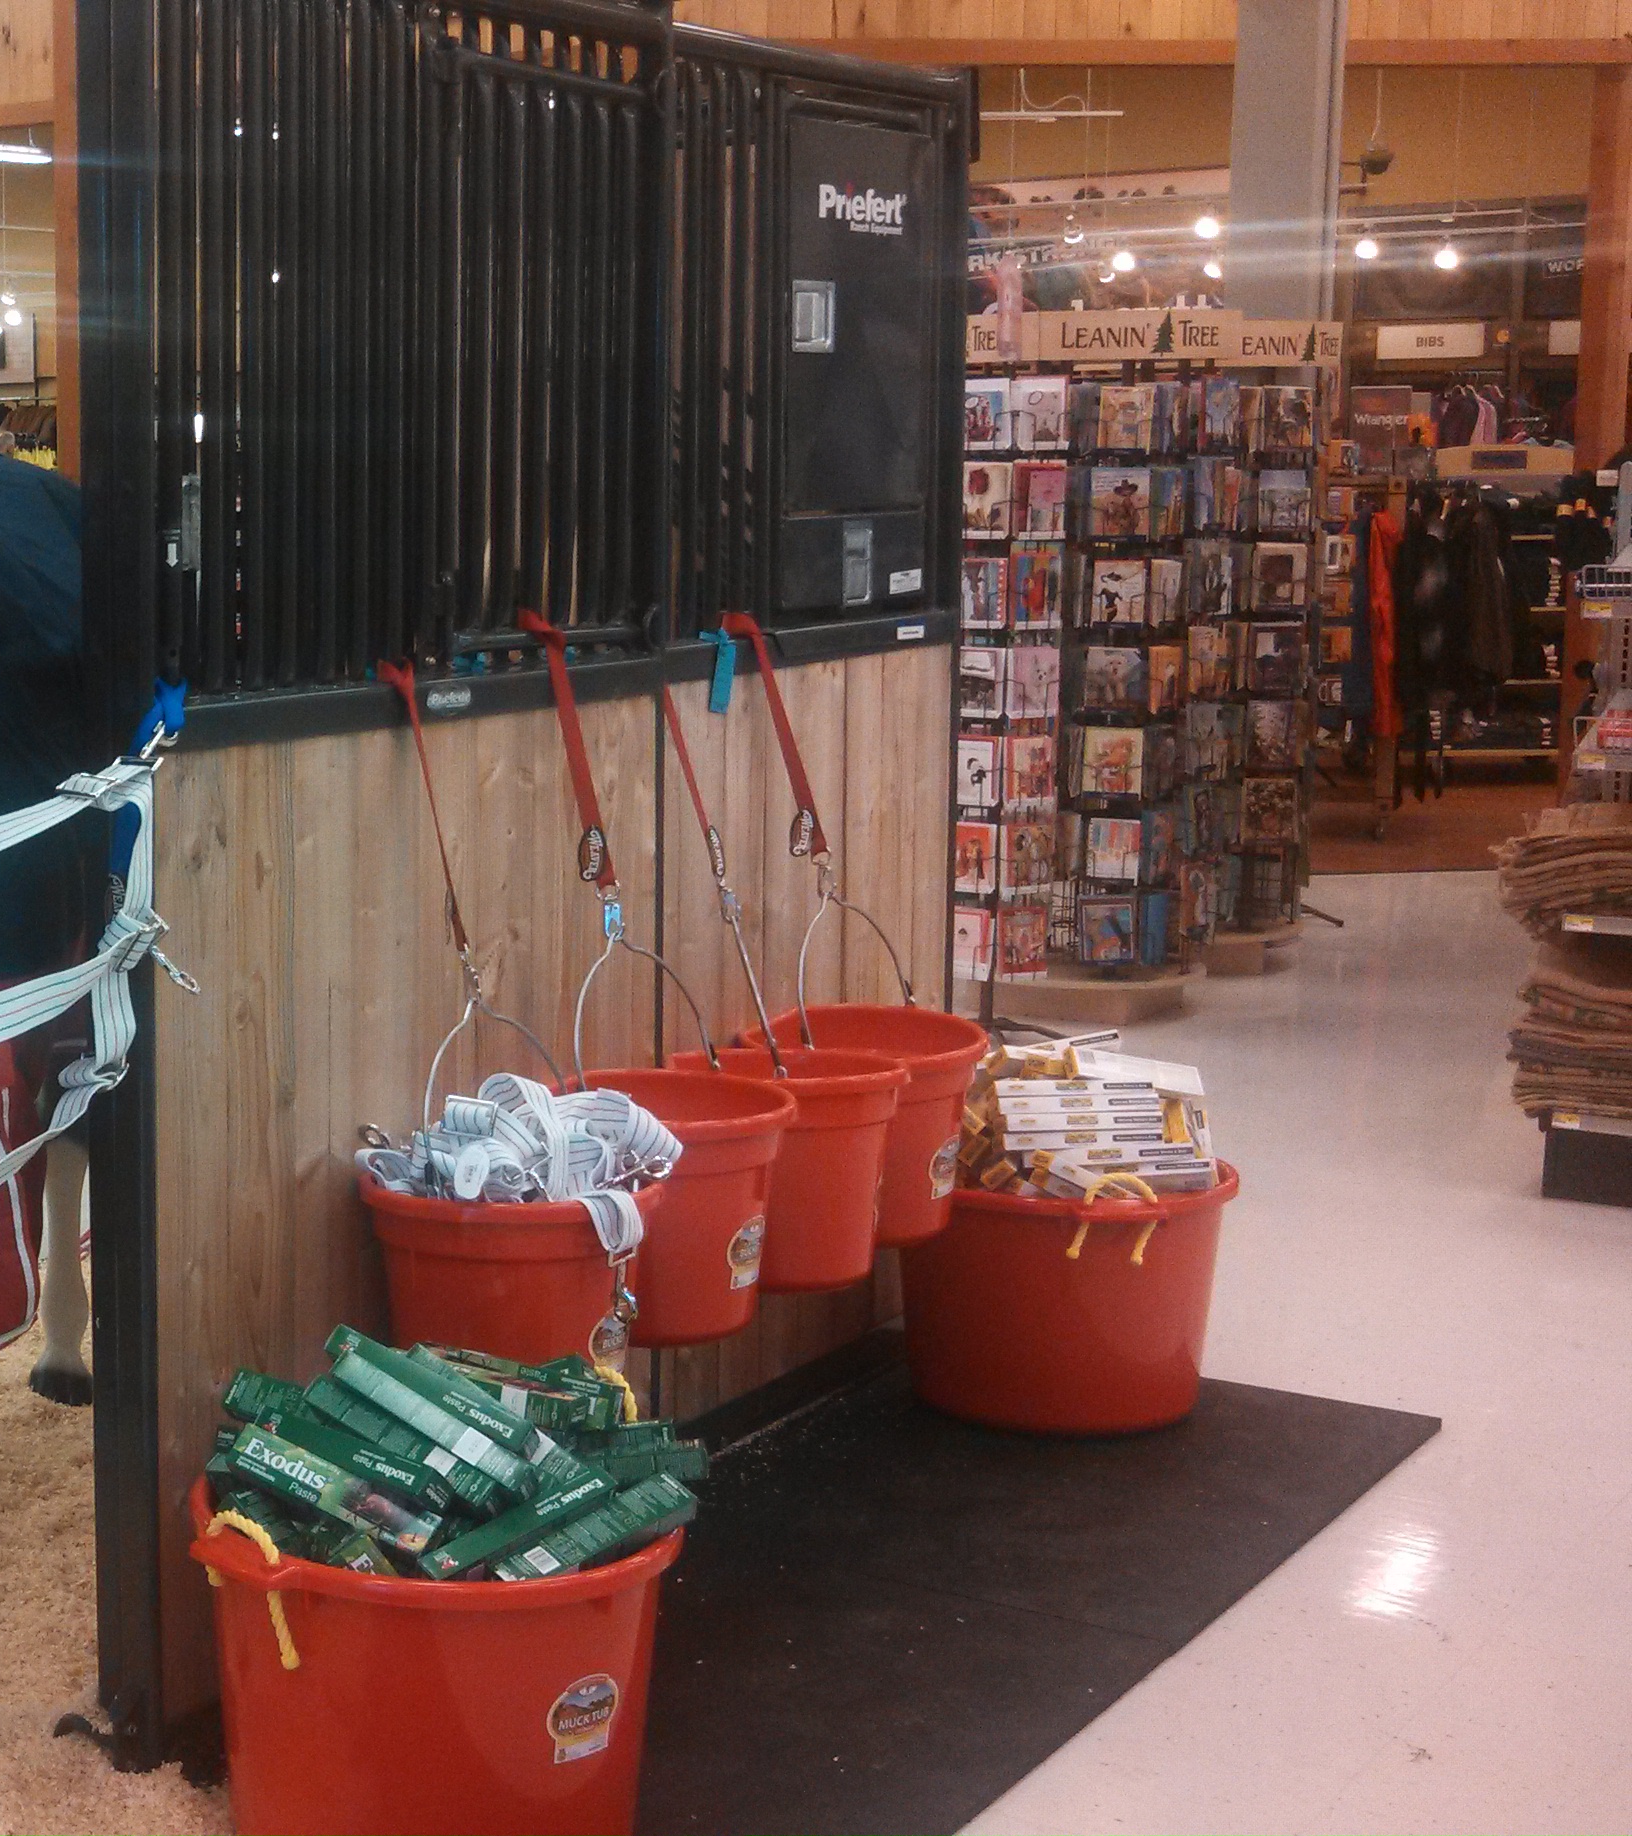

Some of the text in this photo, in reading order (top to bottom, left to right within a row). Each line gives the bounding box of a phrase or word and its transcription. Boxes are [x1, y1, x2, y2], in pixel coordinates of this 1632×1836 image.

[818, 181, 904, 225] Priefert
[1177, 319, 1220, 348] TREE
[1241, 331, 1340, 357] EANIN' TREE
[1415, 335, 1445, 348] BIBS
[442, 1393, 466, 1413] Paste
[468, 1407, 515, 1440] Exodus
[243, 1436, 328, 1490] Exodus
[375, 1461, 416, 1487] Exodus
[287, 1481, 320, 1504] Paste
[560, 1477, 605, 1506] Exodus
[557, 1713, 590, 1732] MUCK
